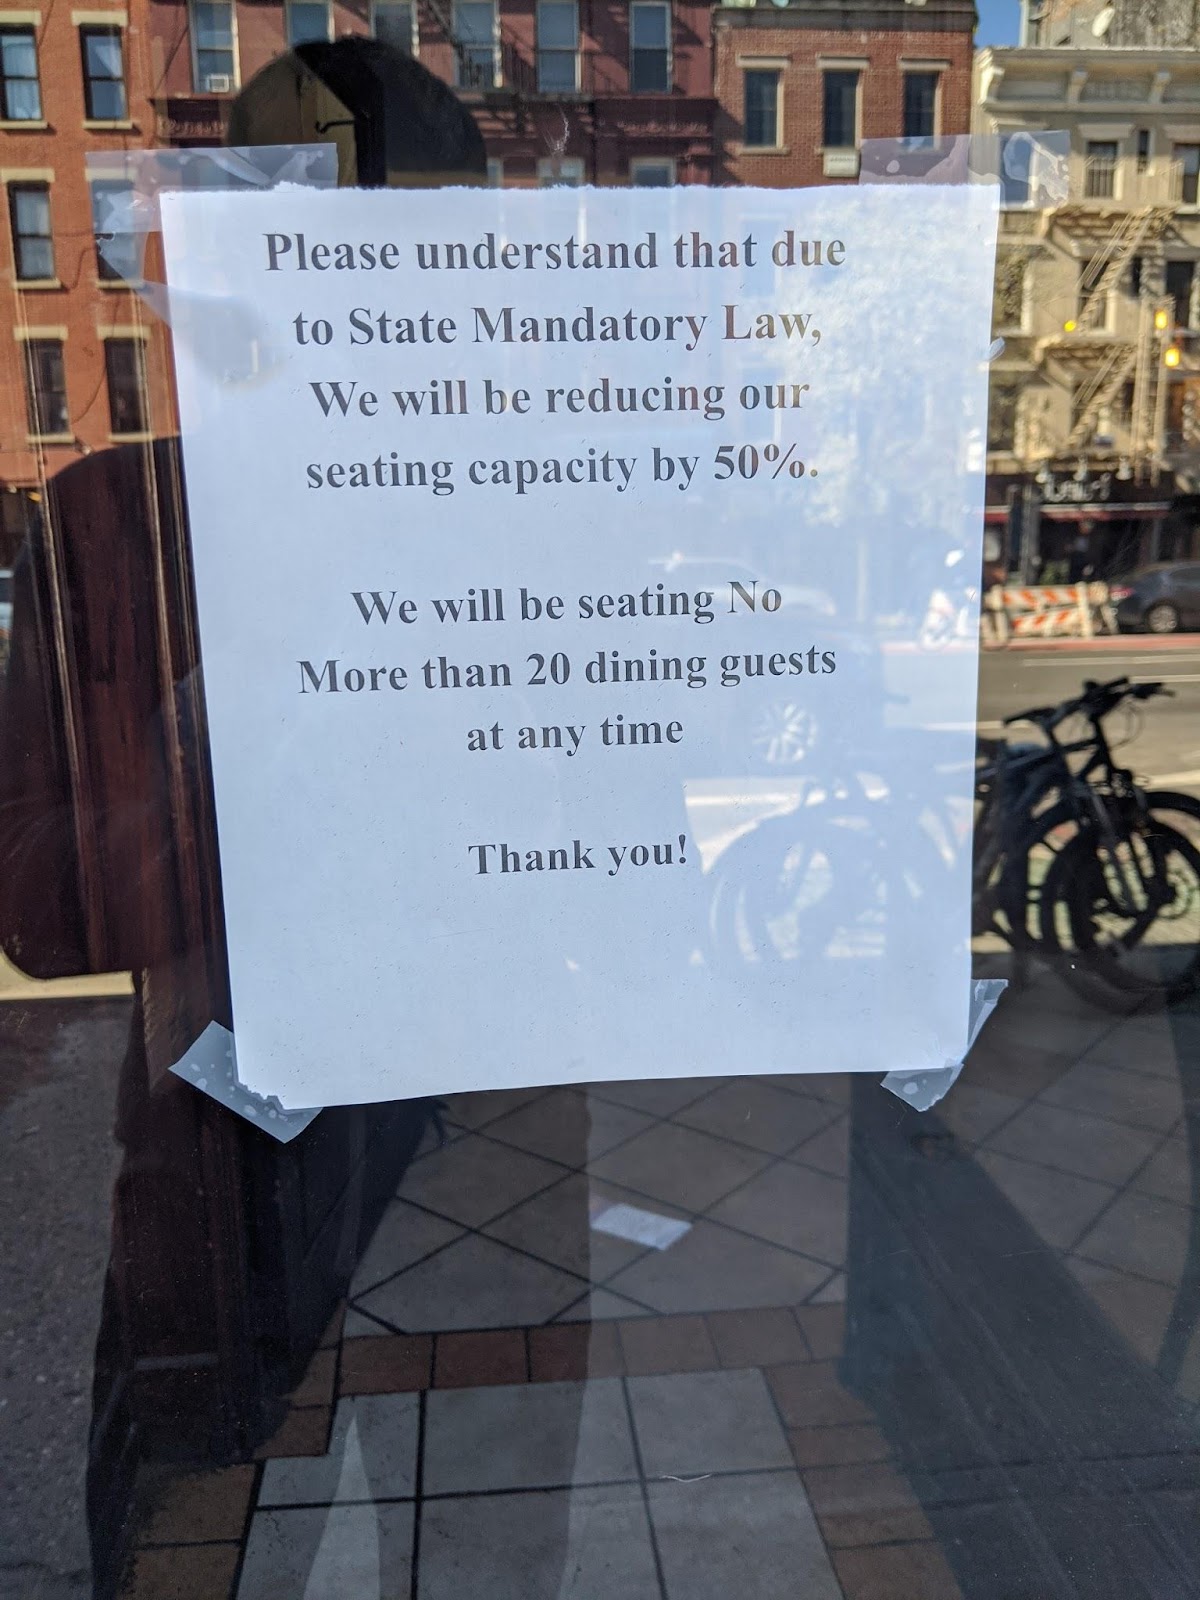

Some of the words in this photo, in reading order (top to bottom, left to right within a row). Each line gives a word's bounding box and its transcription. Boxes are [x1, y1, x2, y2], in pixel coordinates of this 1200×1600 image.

[262, 234, 400, 270] Please
[415, 232, 658, 269] understand
[674, 232, 757, 268] that
[772, 230, 845, 266] due
[293, 312, 333, 345] to
[349, 308, 456, 345] State
[471, 307, 708, 351] Mandatory
[722, 305, 821, 346] Law,
[308, 382, 378, 417] We
[392, 380, 469, 416] will
[482, 380, 530, 414] be
[546, 377, 725, 421] reducing
[740, 384, 809, 410] our
[307, 452, 454, 496] seating
[469, 448, 637, 494] capacity
[652, 447, 700, 491] by
[715, 443, 817, 479] 50%.
[350, 591, 417, 625] We
[431, 589, 505, 623] will
[519, 588, 564, 620] be
[579, 583, 714, 624] seating
[727, 581, 781, 613] No
[296, 660, 407, 693] More
[421, 657, 512, 689] than
[527, 652, 570, 685] 20
[586, 649, 706, 688] dining
[721, 645, 836, 687] guests
[468, 721, 504, 751] at
[518, 726, 586, 756] any
[600, 714, 683, 745] time
[468, 840, 596, 874] Thank
[607, 834, 686, 876] you!
